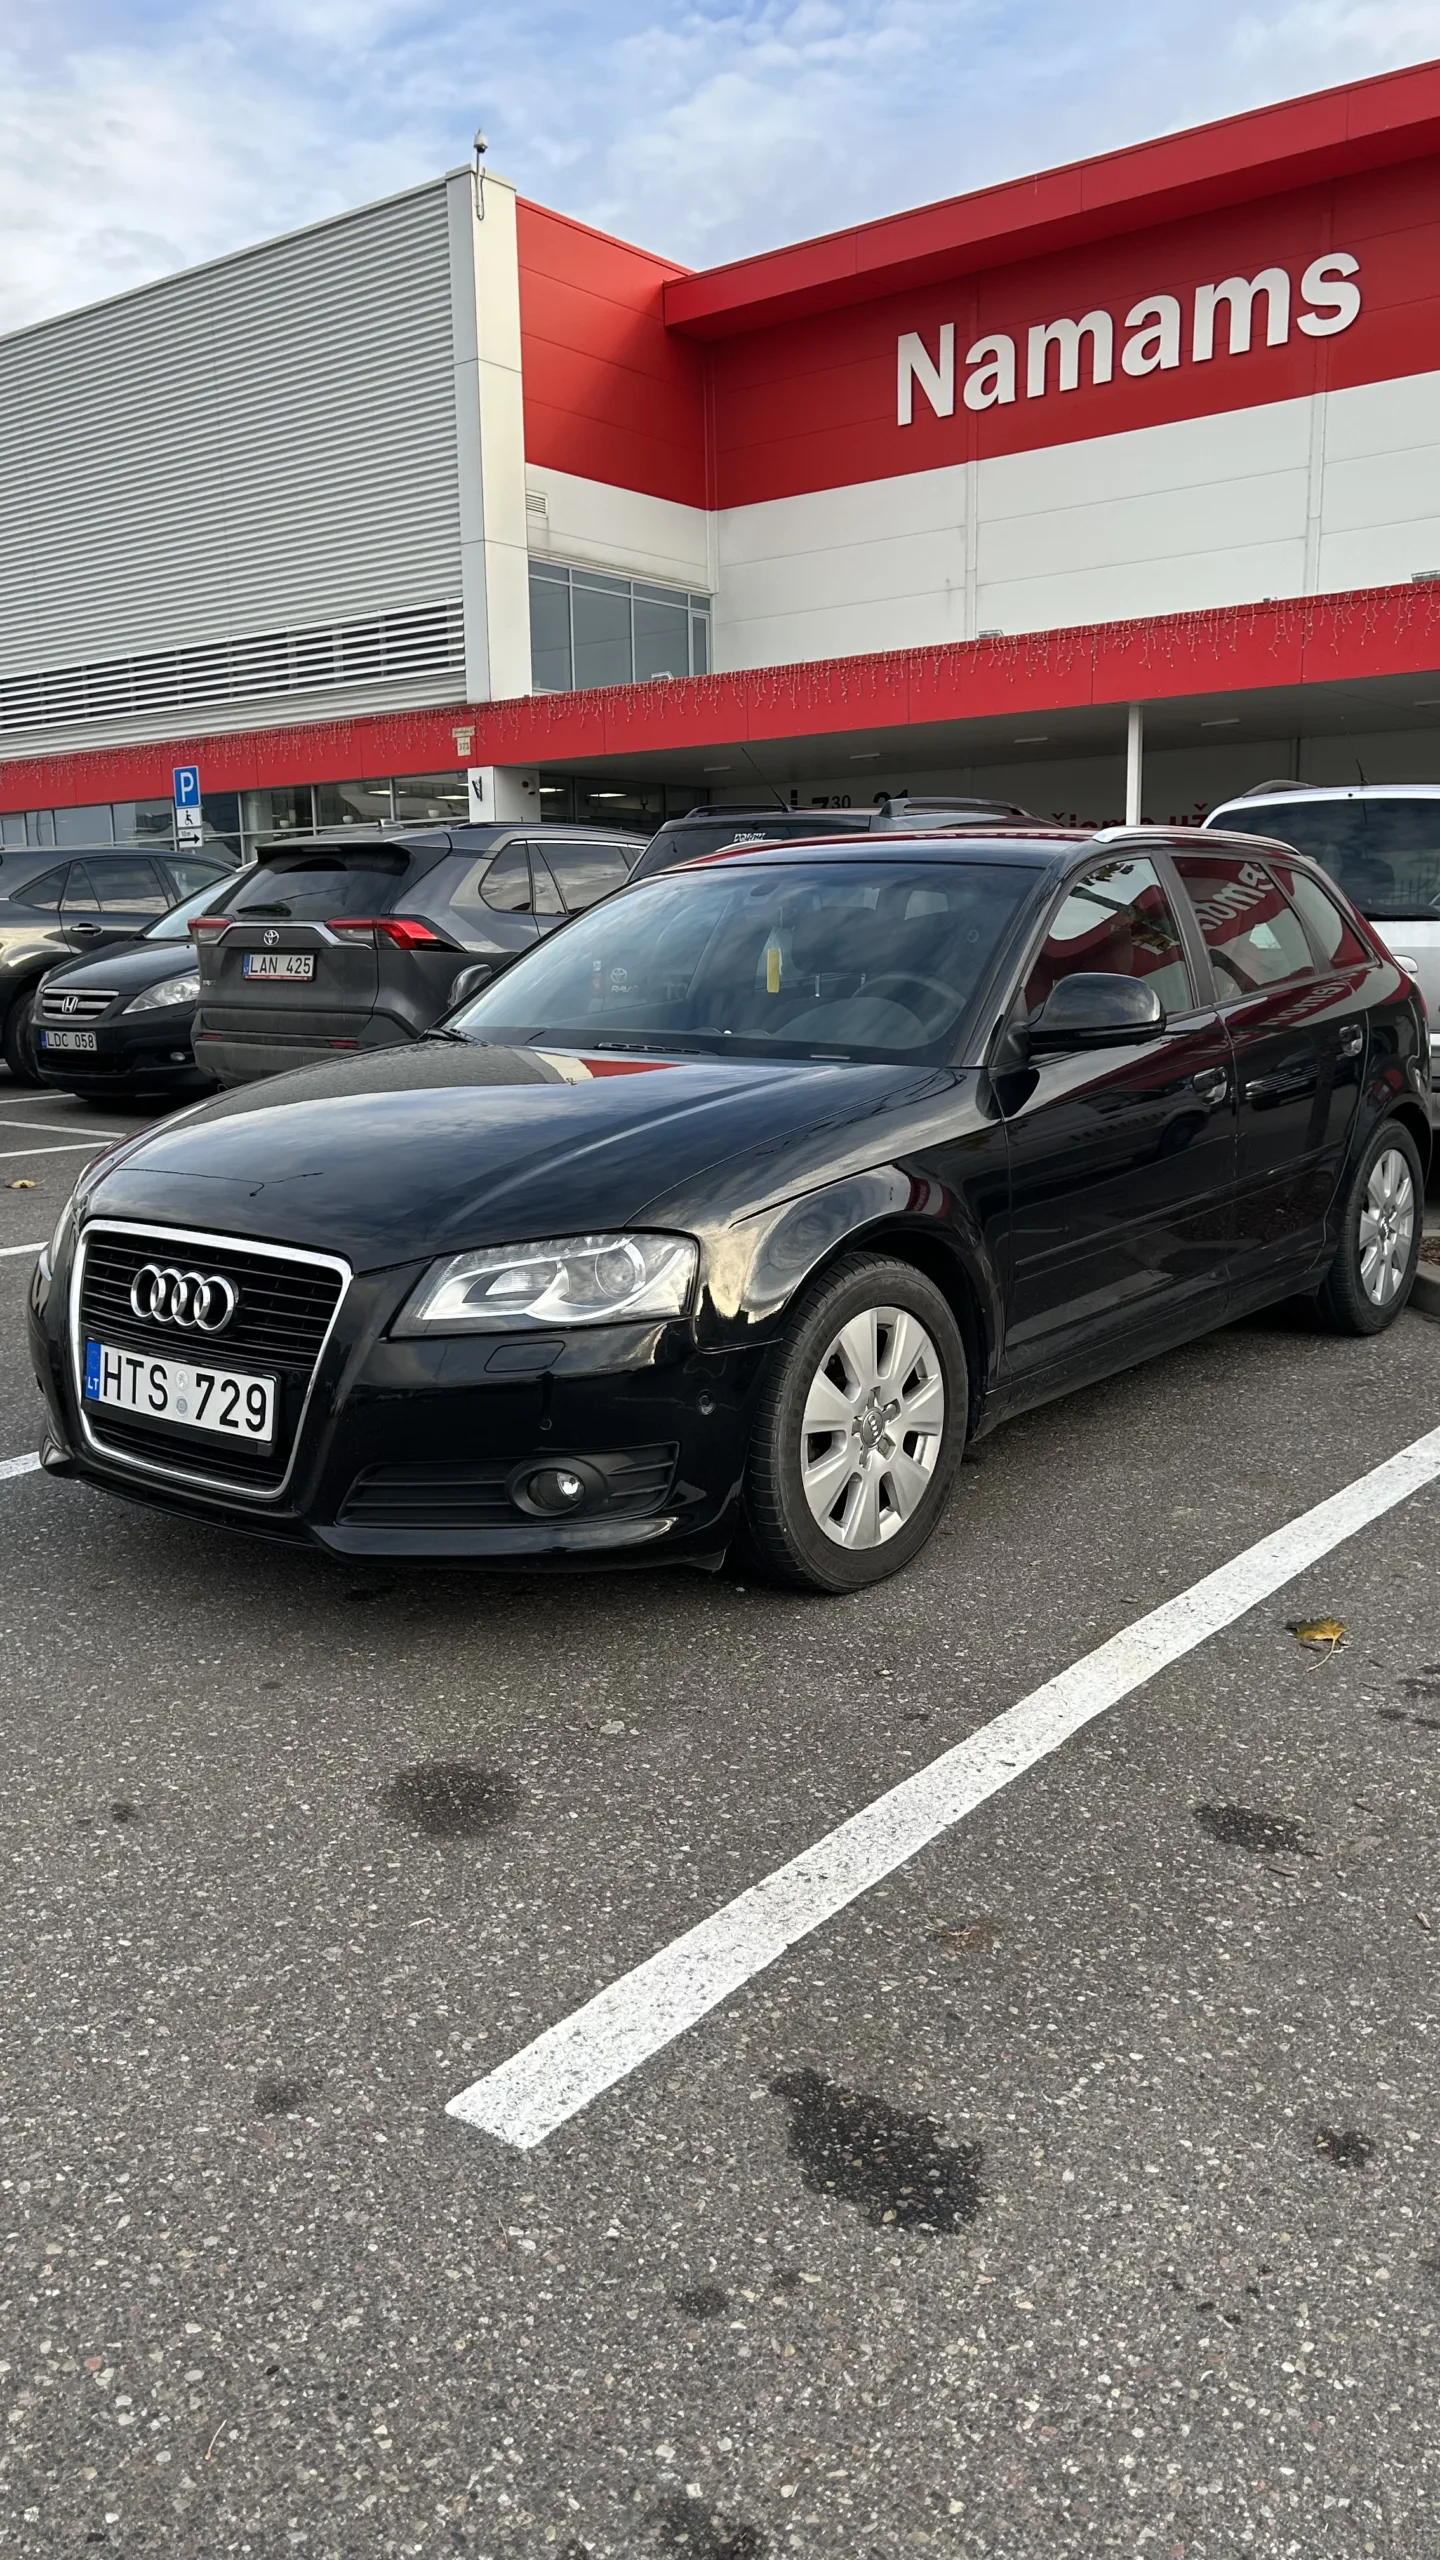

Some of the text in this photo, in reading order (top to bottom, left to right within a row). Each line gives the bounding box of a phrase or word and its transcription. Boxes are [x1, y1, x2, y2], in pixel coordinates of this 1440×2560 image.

[897, 251, 1361, 426] Namams
[180, 771, 194, 803] P
[250, 957, 278, 974] LAN
[286, 957, 311, 974] 425
[47, 1032, 69, 1047] LDC
[74, 1033, 95, 1049] 058
[87, 1351, 267, 1432] LT HTS 729
